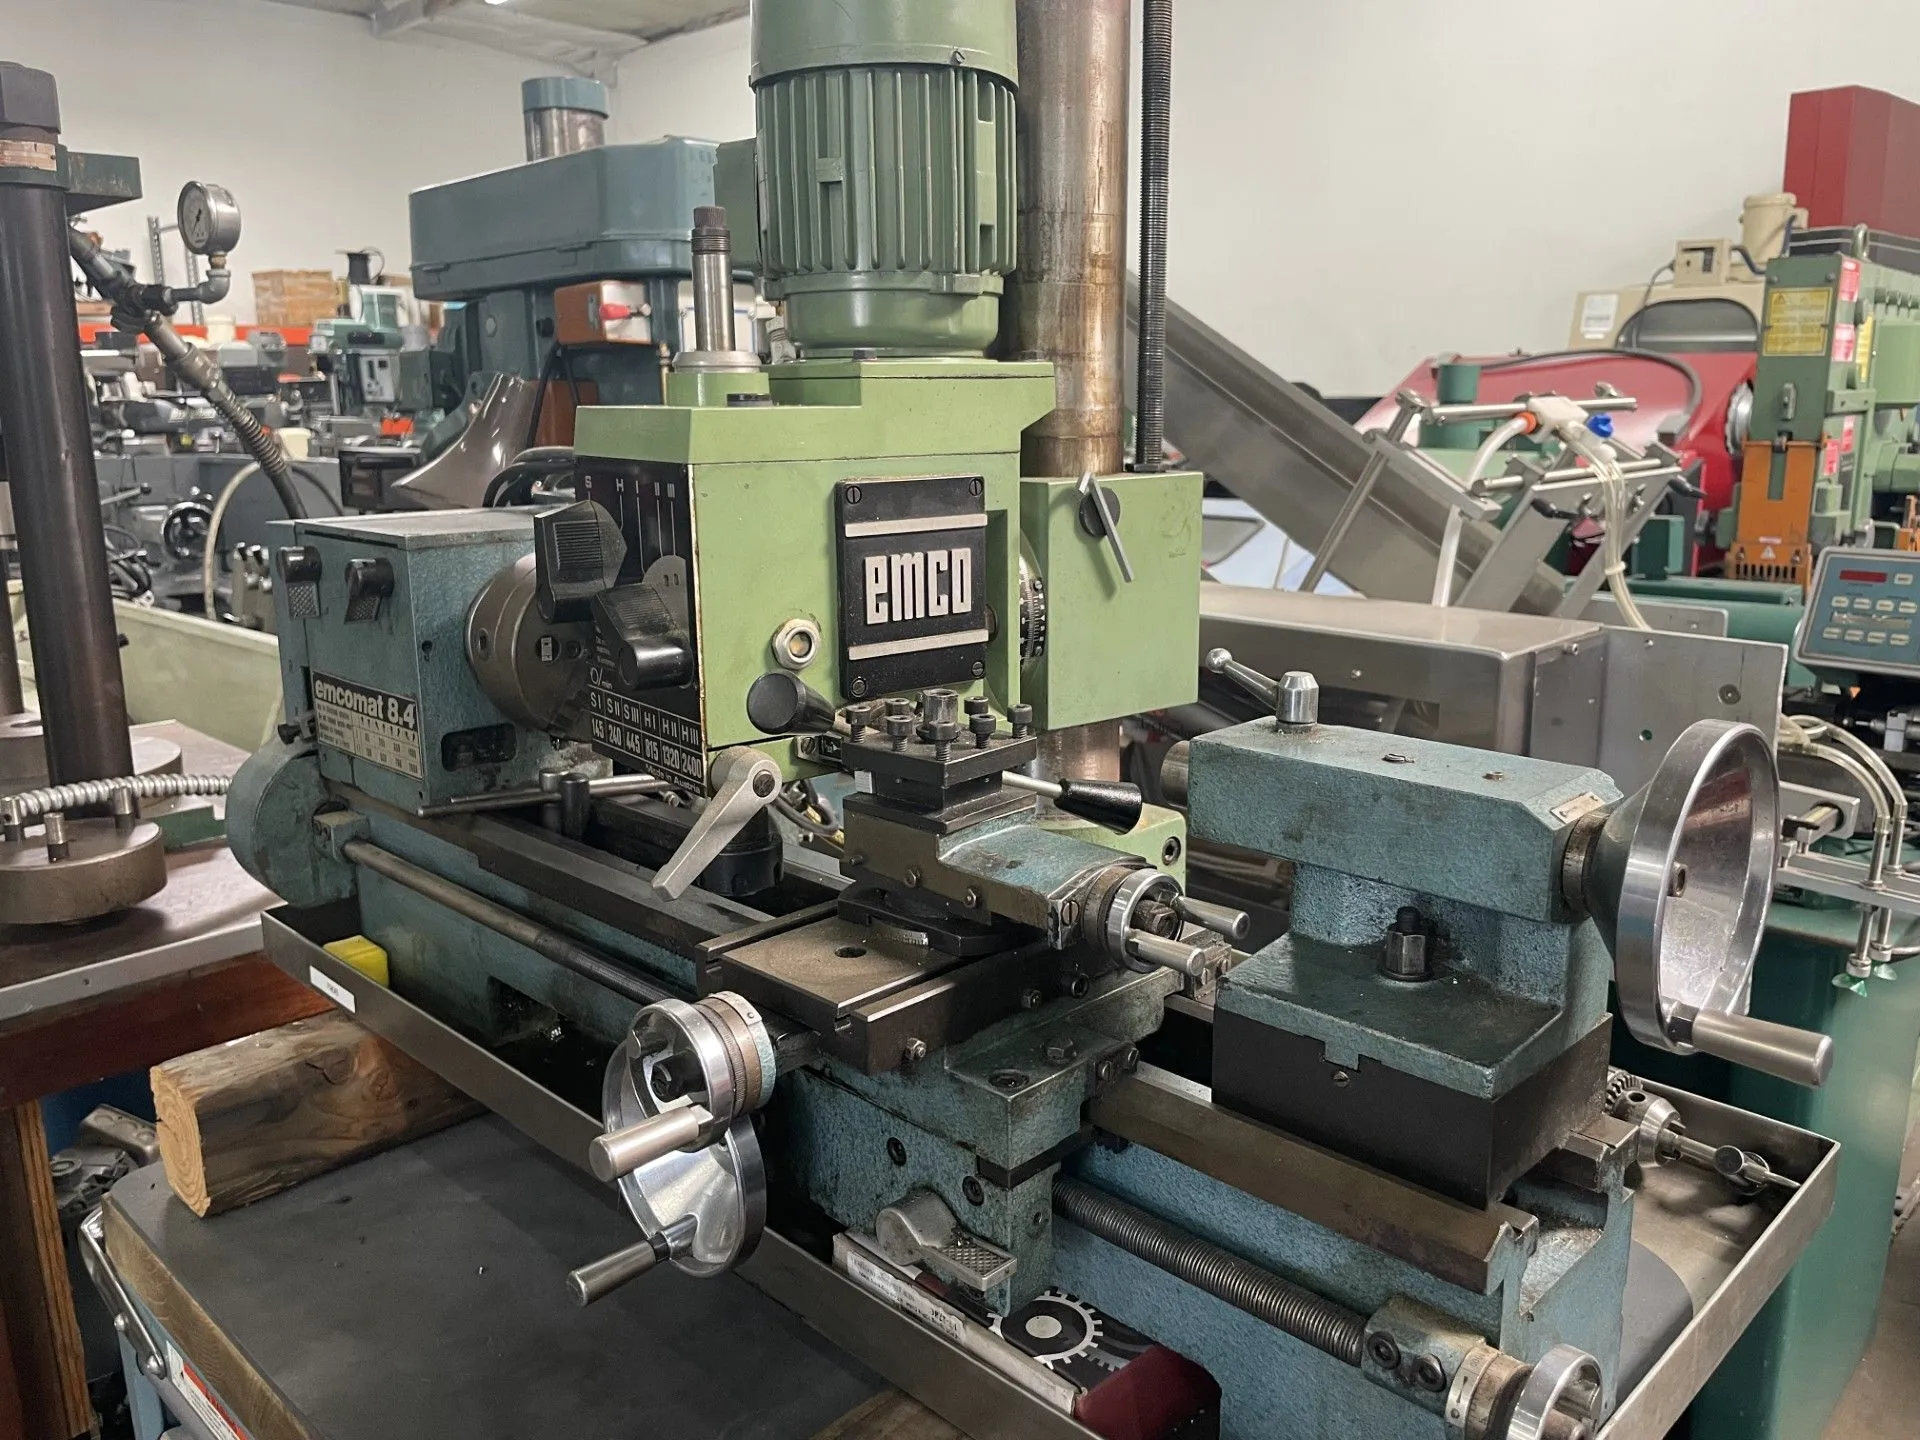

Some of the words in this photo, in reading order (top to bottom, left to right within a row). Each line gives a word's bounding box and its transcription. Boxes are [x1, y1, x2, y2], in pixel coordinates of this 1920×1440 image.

[584, 475, 592, 489] S
[616, 478, 625, 492] H
[865, 547, 972, 625] emco
[315, 680, 384, 719] emcomat
[387, 698, 415, 729] 8.4
[591, 718, 605, 739] 145
[608, 725, 622, 746] 240
[626, 732, 641, 754] 445
[645, 739, 659, 761] 815
[662, 745, 680, 770] 1320
[682, 752, 702, 779] 2400
[646, 763, 665, 779] Made
[674, 775, 701, 794] Austria
